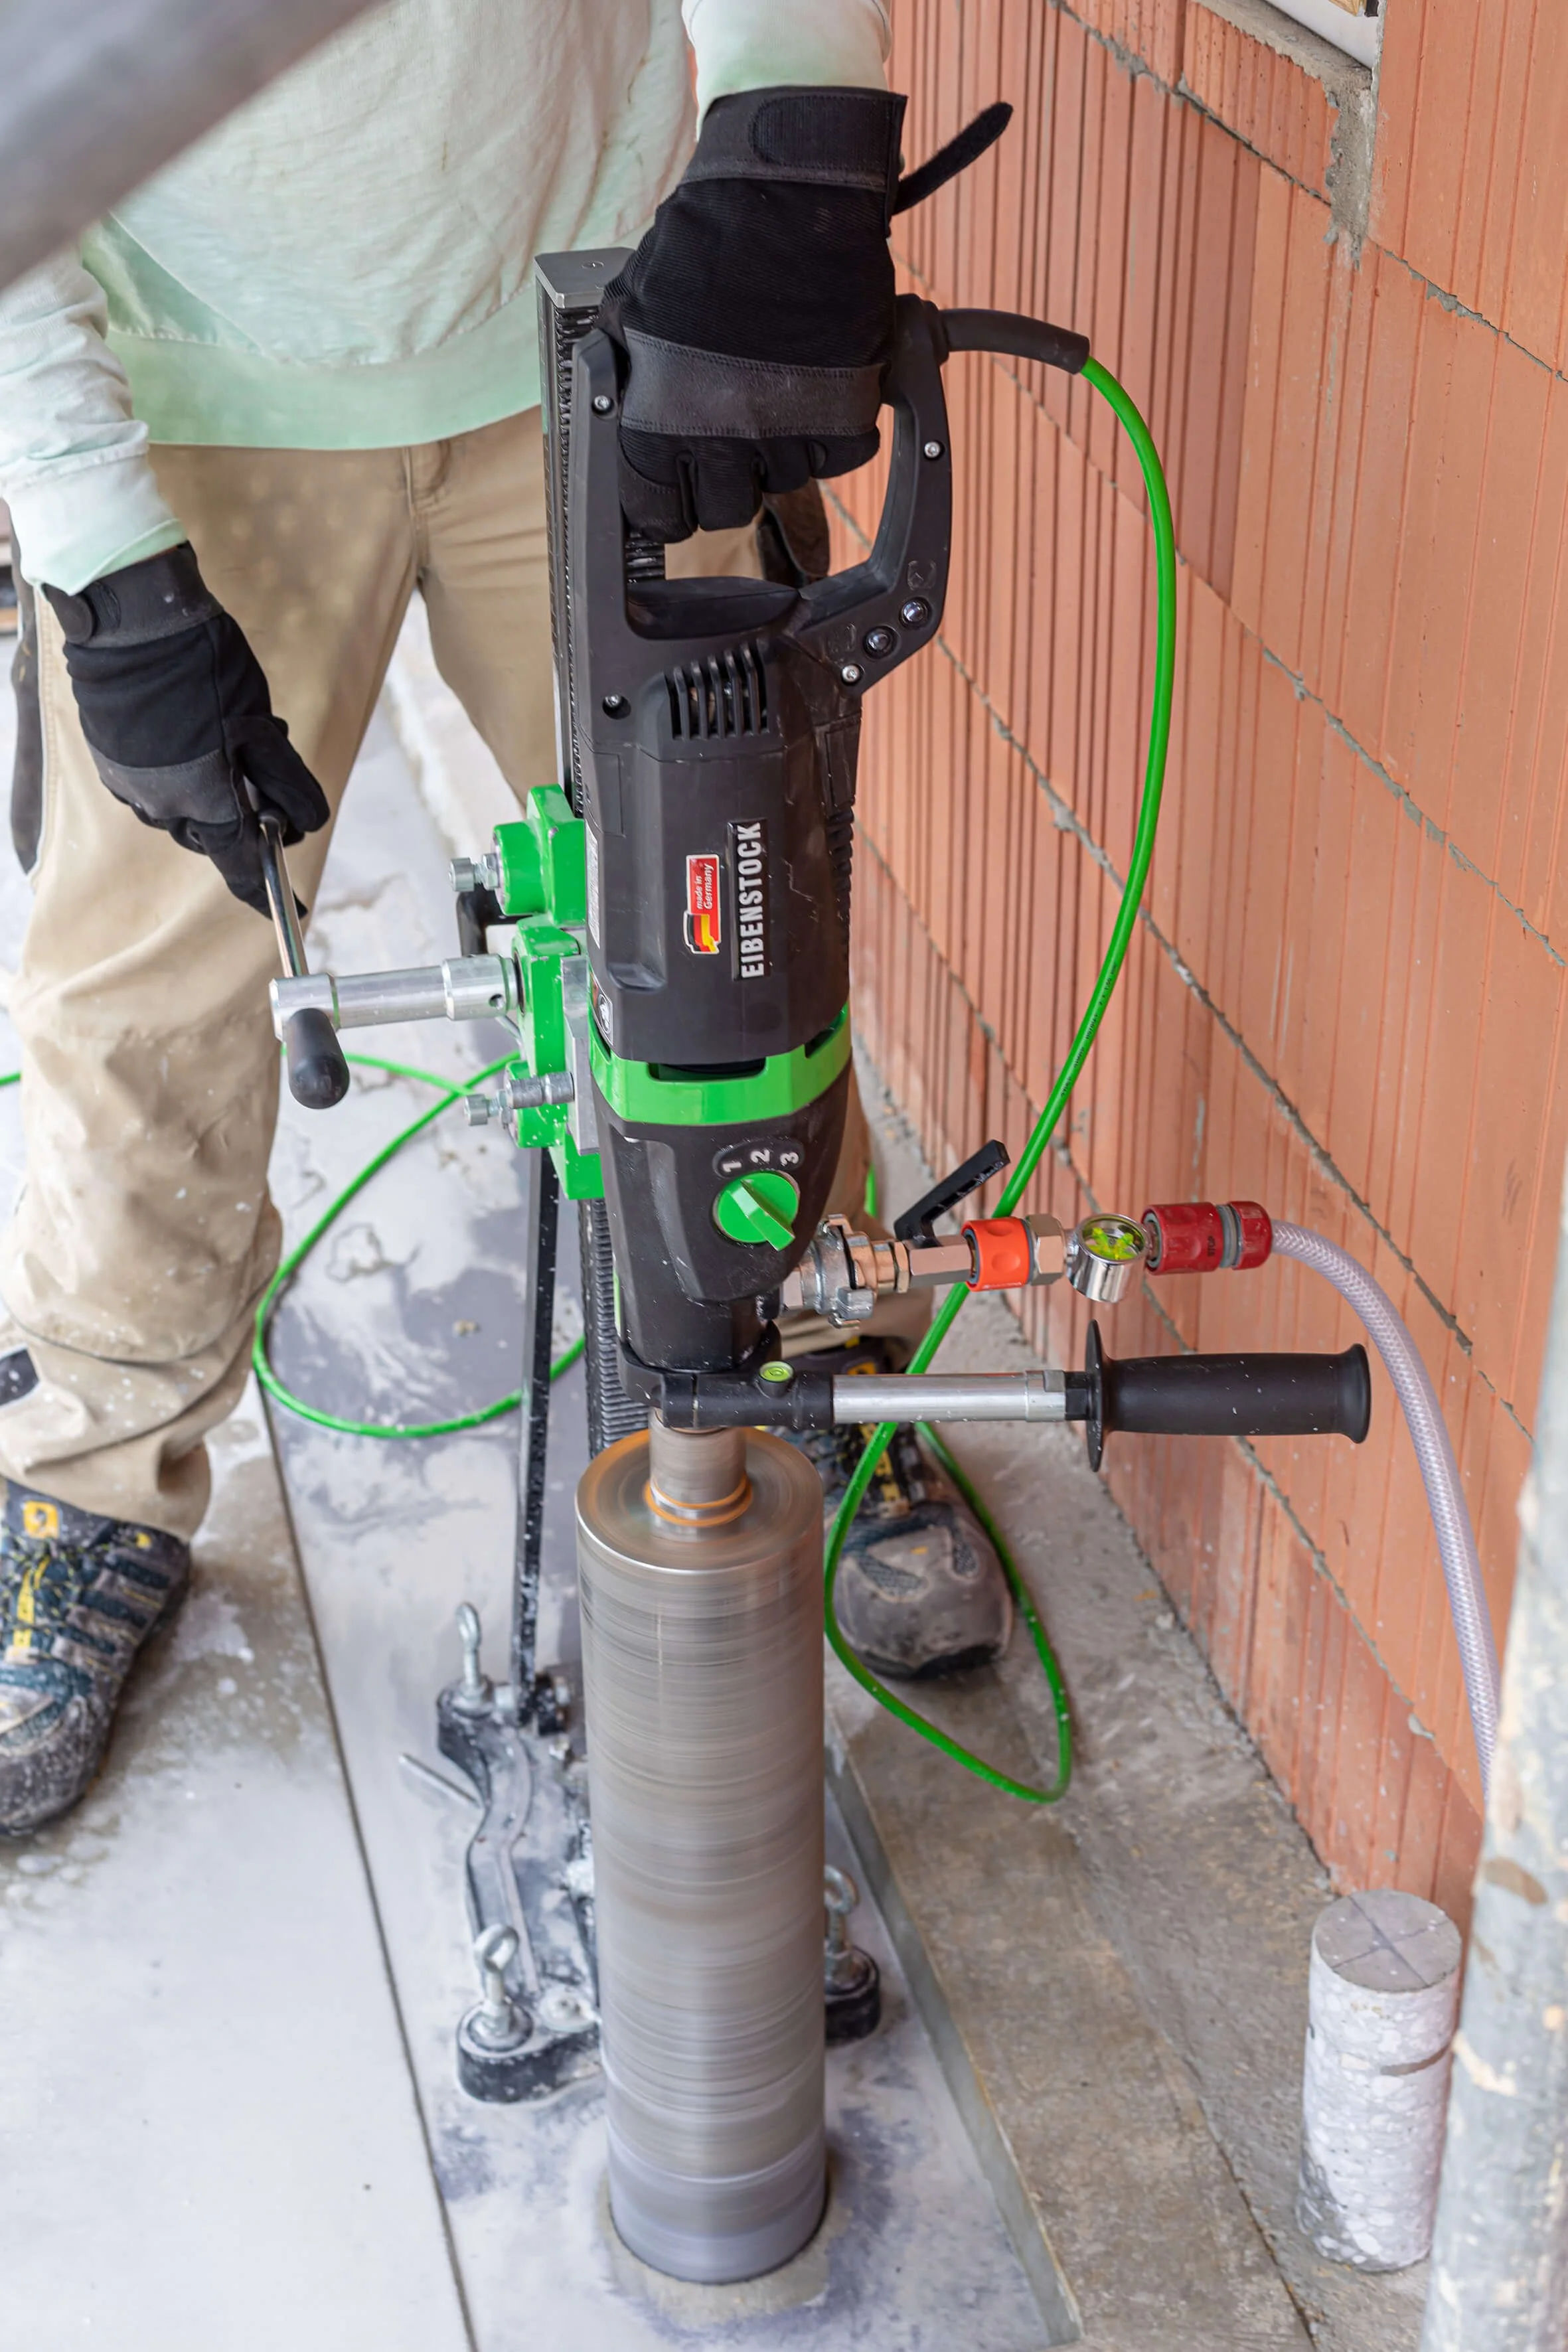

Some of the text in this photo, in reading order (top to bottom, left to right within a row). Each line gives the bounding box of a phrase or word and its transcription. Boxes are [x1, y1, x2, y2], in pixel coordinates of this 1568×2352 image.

[695, 874, 702, 884] in
[704, 863, 714, 909] Germany
[737, 822, 764, 979] EIBENSTOCK
[722, 1149, 799, 1172] 1 2 3
